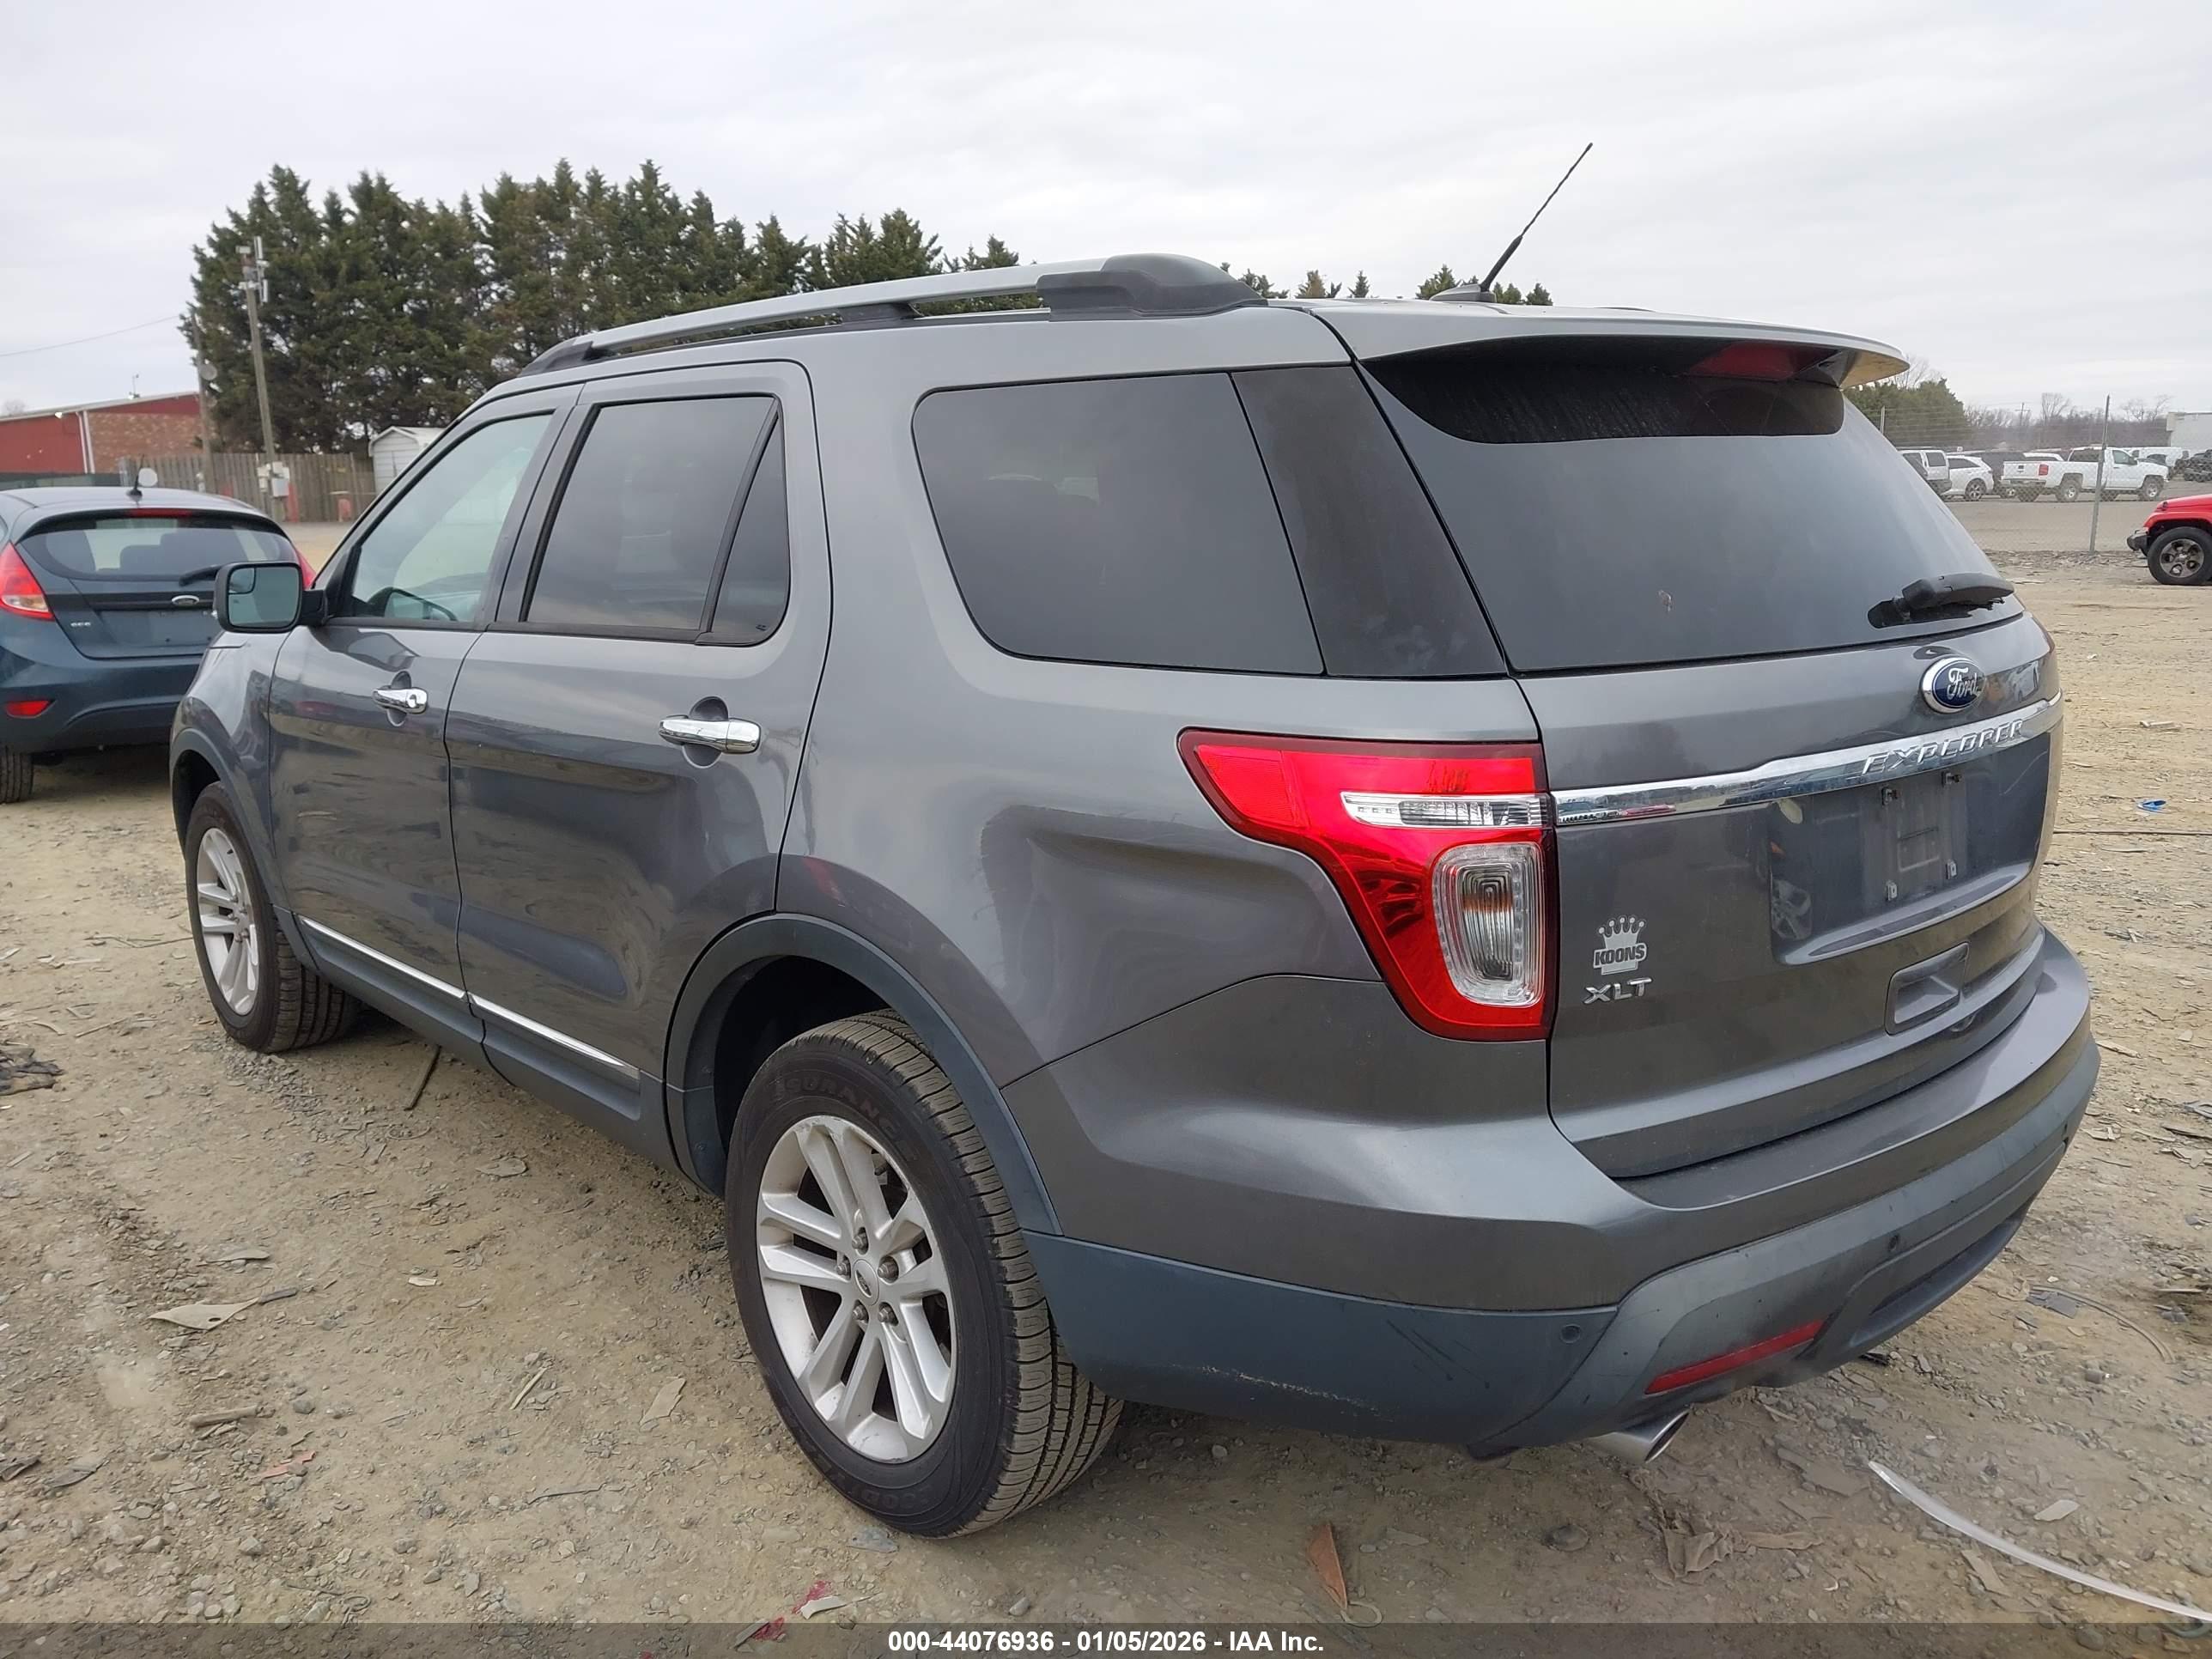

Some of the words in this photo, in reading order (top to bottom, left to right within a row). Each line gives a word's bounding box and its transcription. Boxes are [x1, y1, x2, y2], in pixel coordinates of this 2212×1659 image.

[1946, 666, 1979, 700] Ford
[1862, 718, 2023, 775] EXPLORER
[1595, 944, 1646, 966] KOONS
[1583, 977, 1652, 1004] XLT
